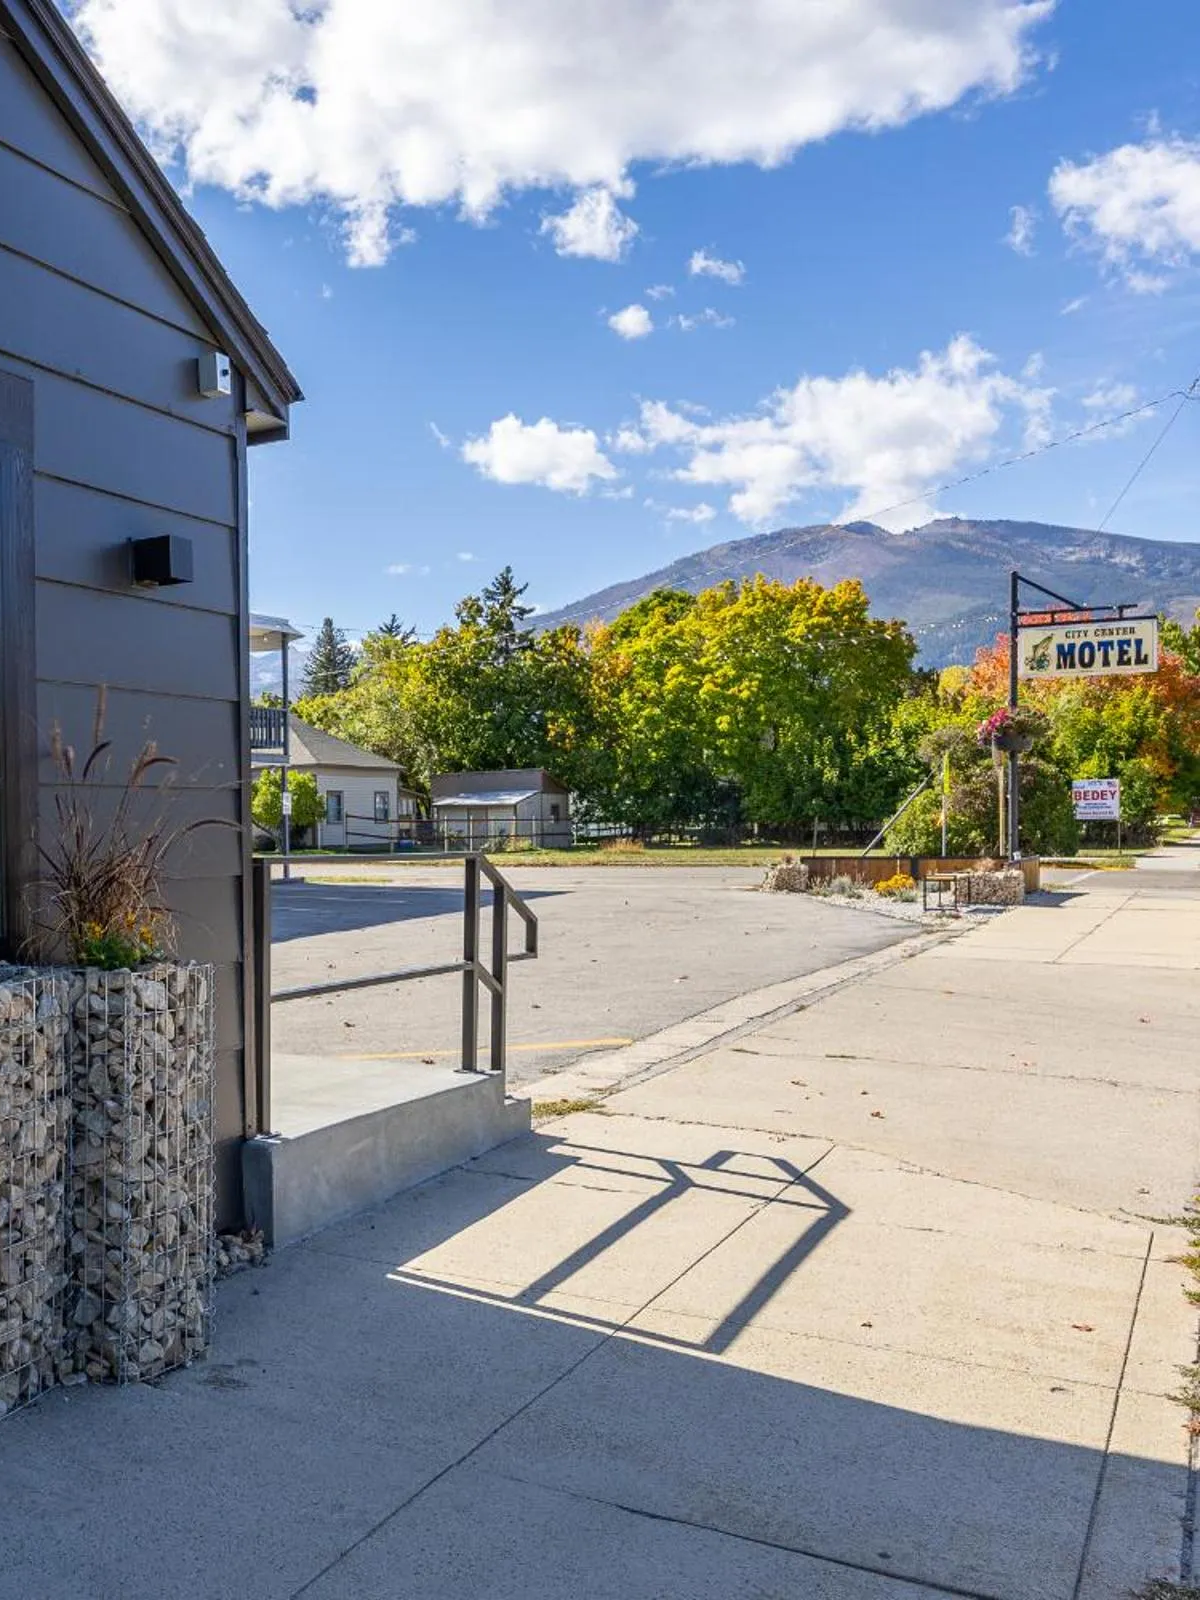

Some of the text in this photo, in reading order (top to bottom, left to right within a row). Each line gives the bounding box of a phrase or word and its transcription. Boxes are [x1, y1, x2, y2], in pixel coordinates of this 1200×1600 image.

[1065, 627, 1136, 639] CITY CENTER
[1056, 638, 1148, 669] MOTEL
[1074, 790, 1117, 801] BEDEY
